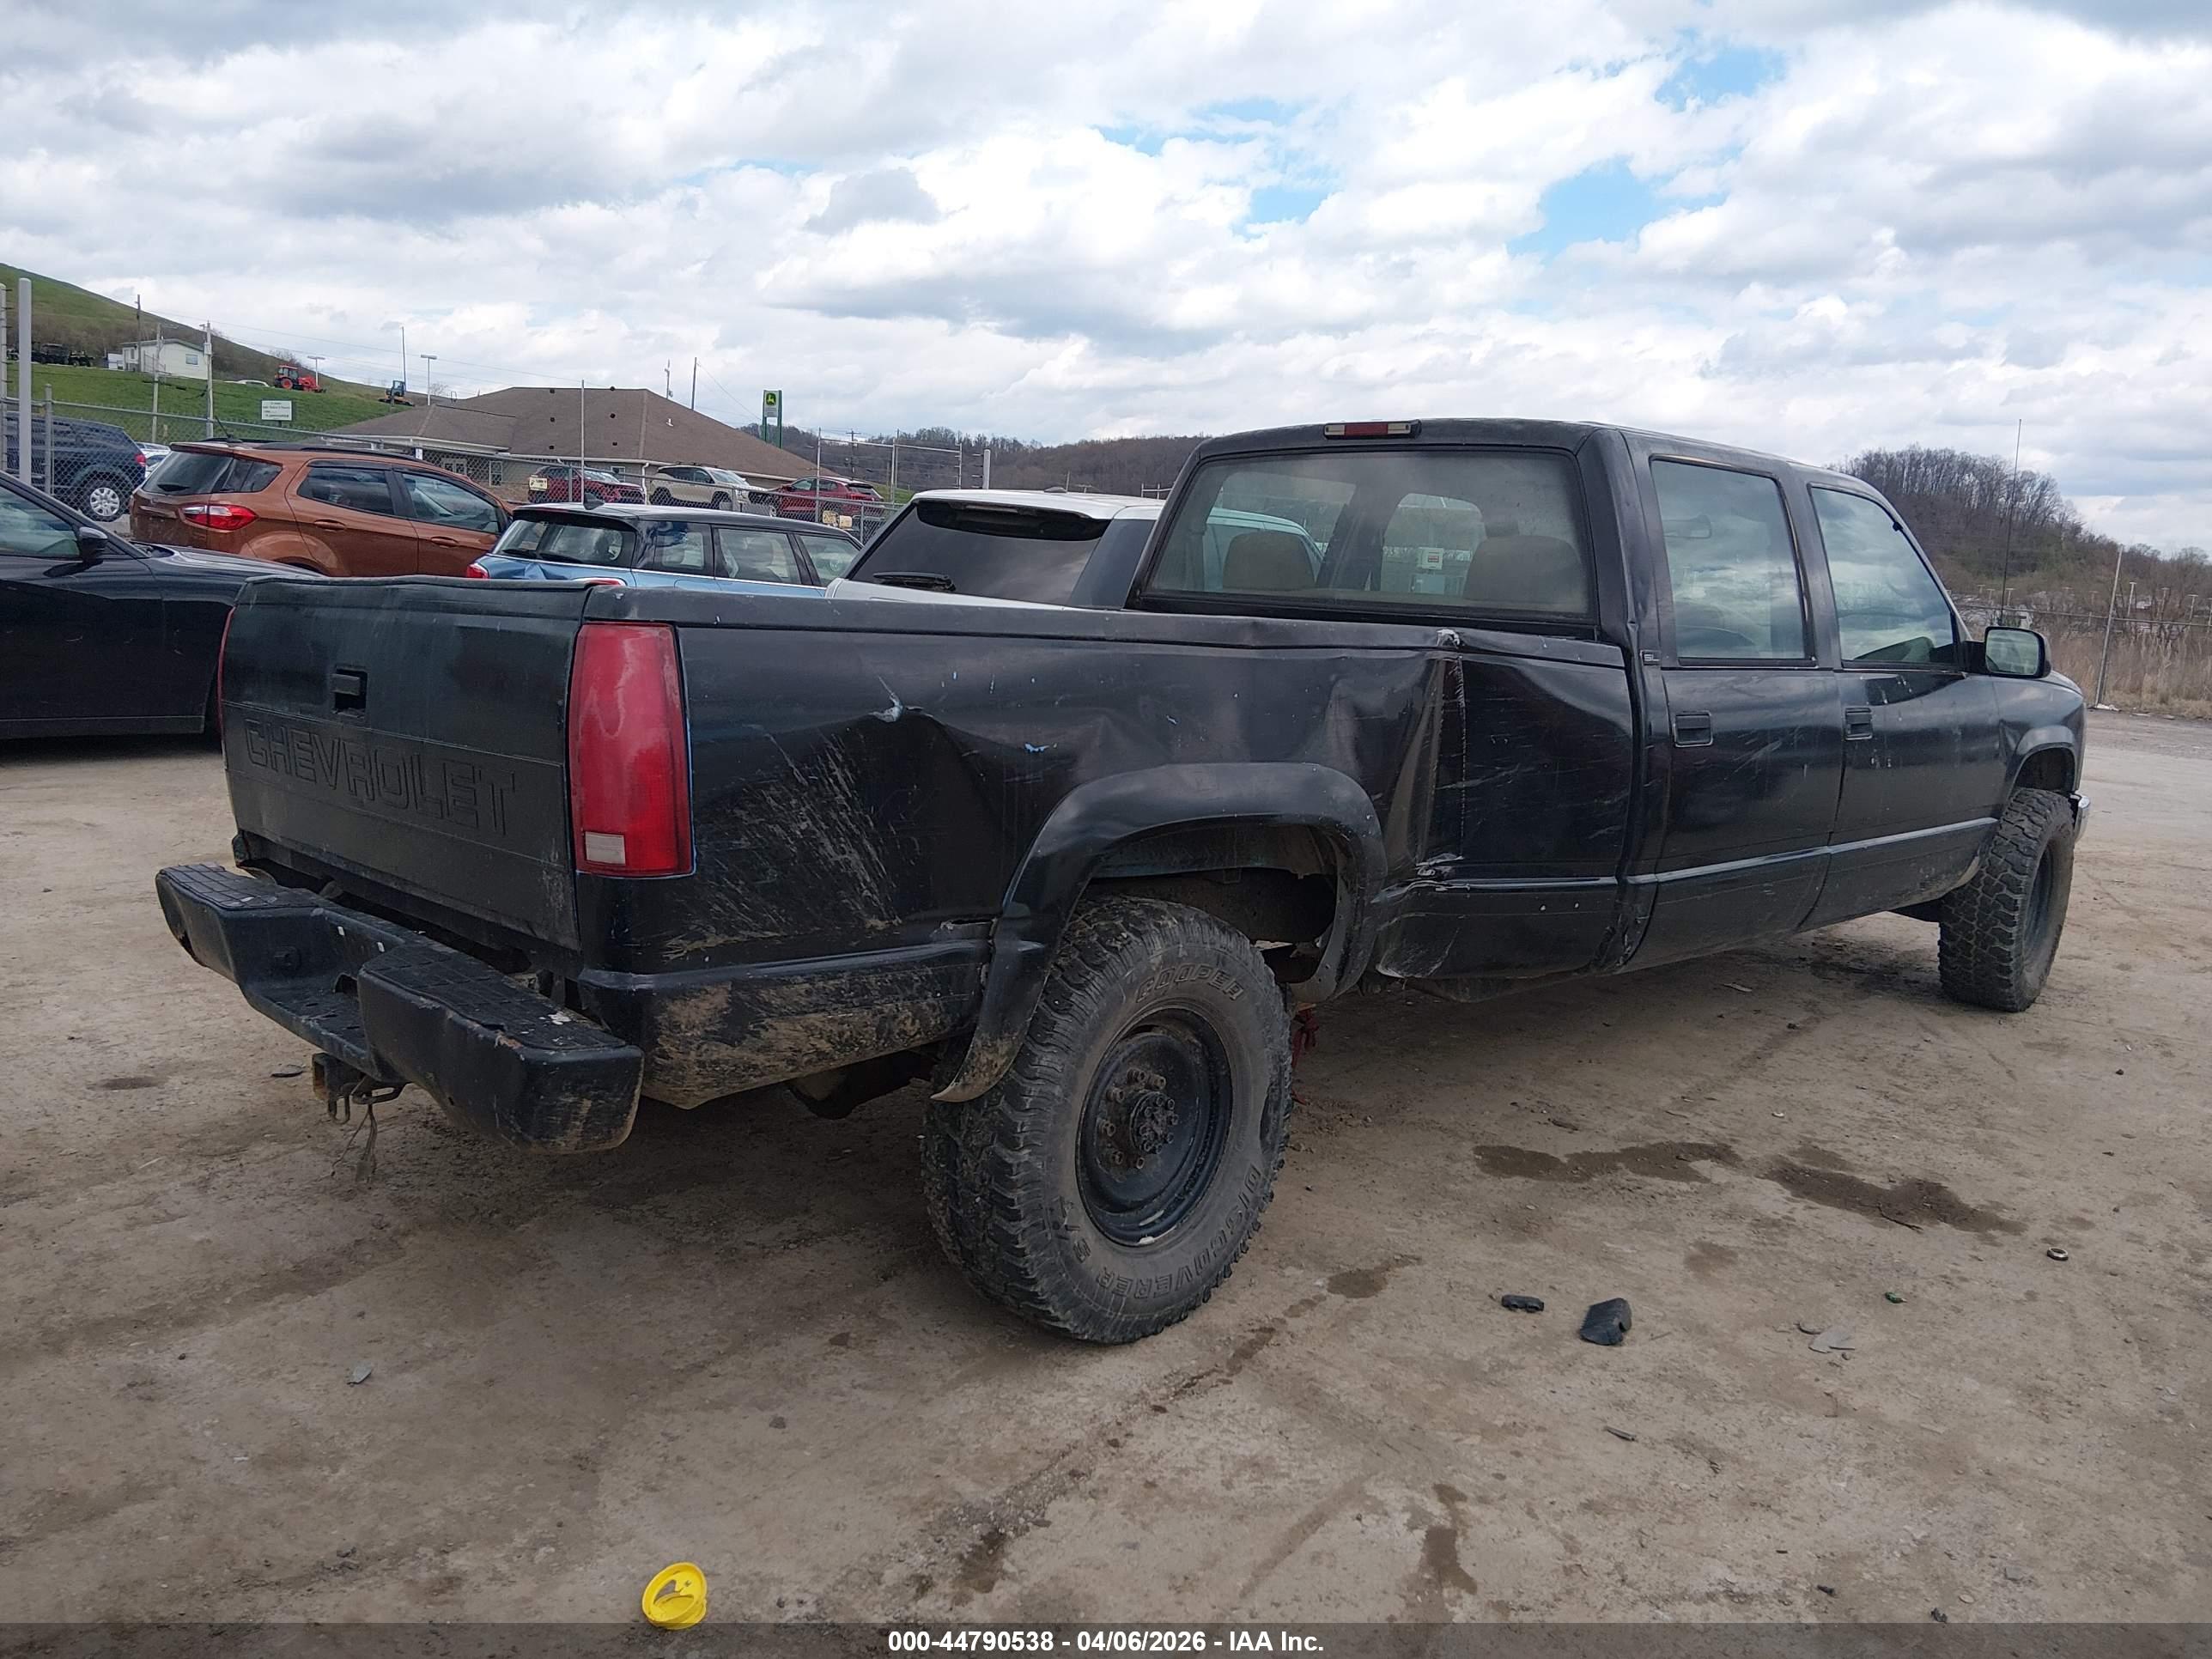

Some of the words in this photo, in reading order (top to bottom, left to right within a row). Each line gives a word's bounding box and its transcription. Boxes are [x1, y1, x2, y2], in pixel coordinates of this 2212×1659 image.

[244, 719, 517, 836] CHEVROLET
[1135, 962, 1245, 1003] COOPER
[1096, 1164, 1261, 1298] DISCOVERER
